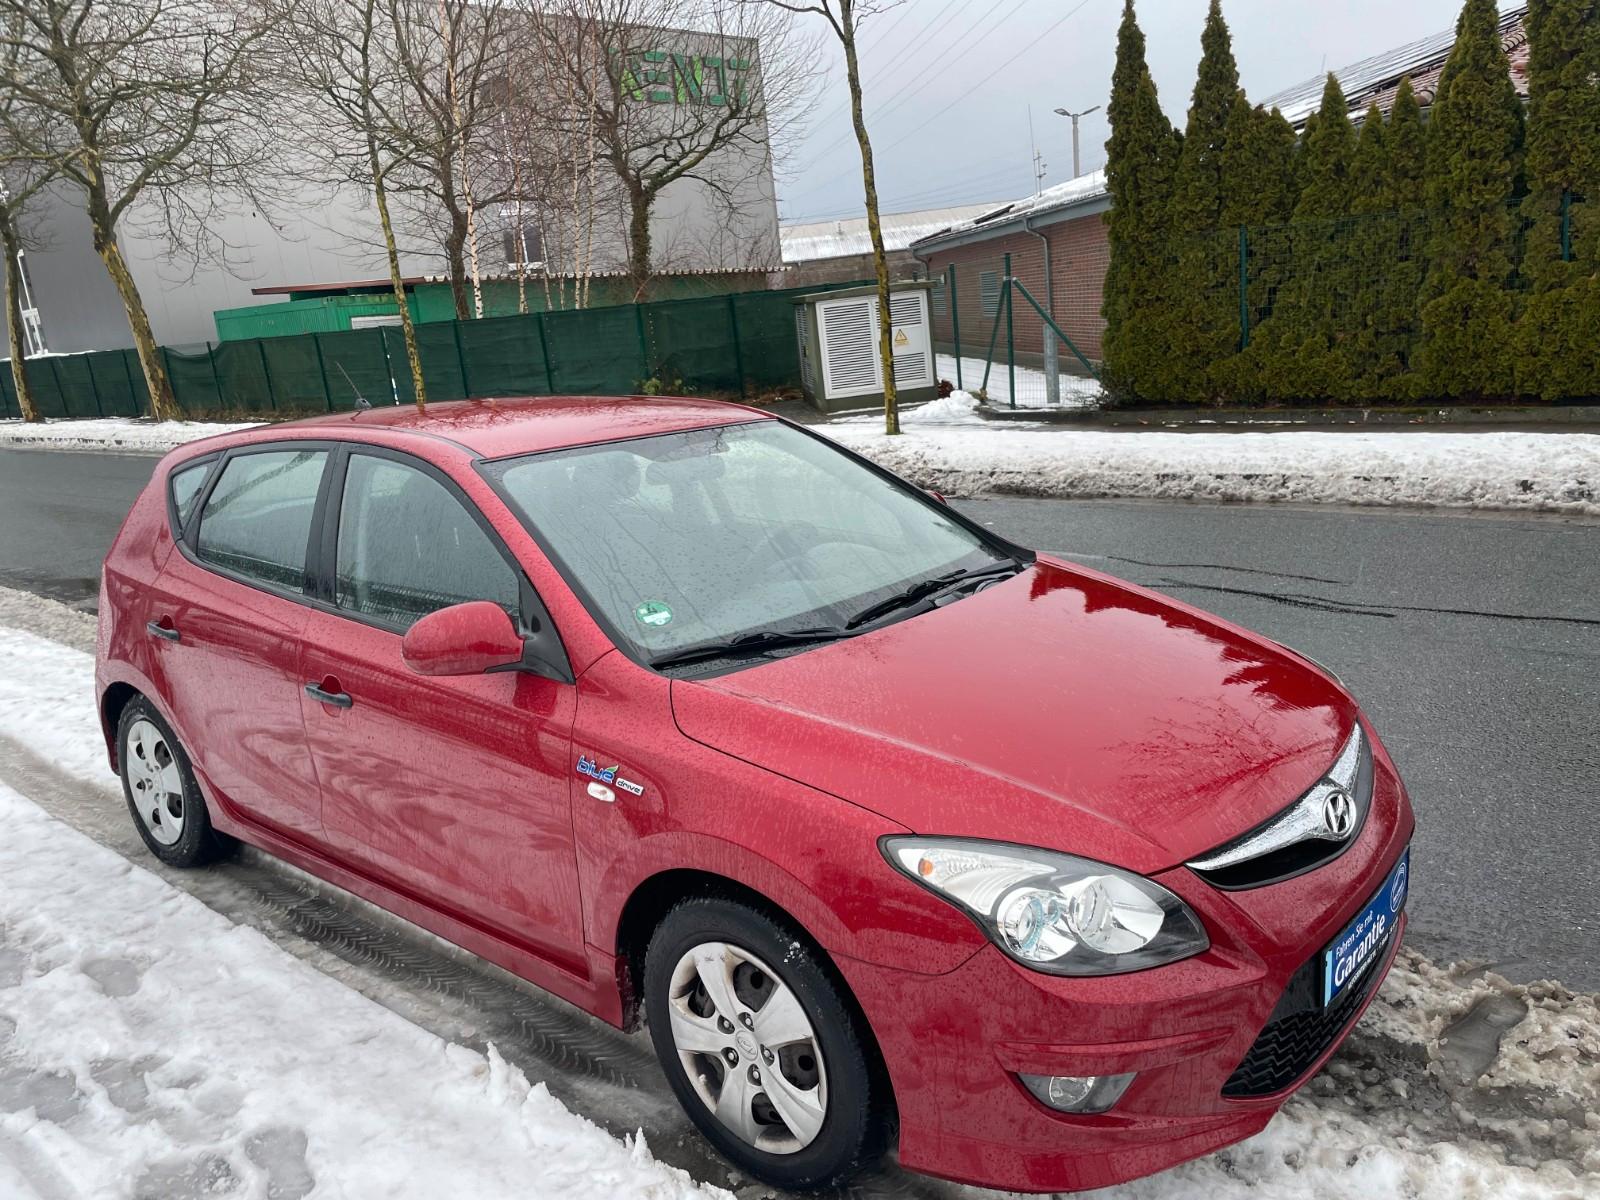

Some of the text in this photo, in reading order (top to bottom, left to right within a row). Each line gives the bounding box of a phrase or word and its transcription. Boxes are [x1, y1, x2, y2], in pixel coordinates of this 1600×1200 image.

[577, 755, 641, 794] blue drive
[1334, 914, 1386, 986] Garantie
[1336, 934, 1355, 961] Fahren
[1364, 910, 1373, 927] mit
